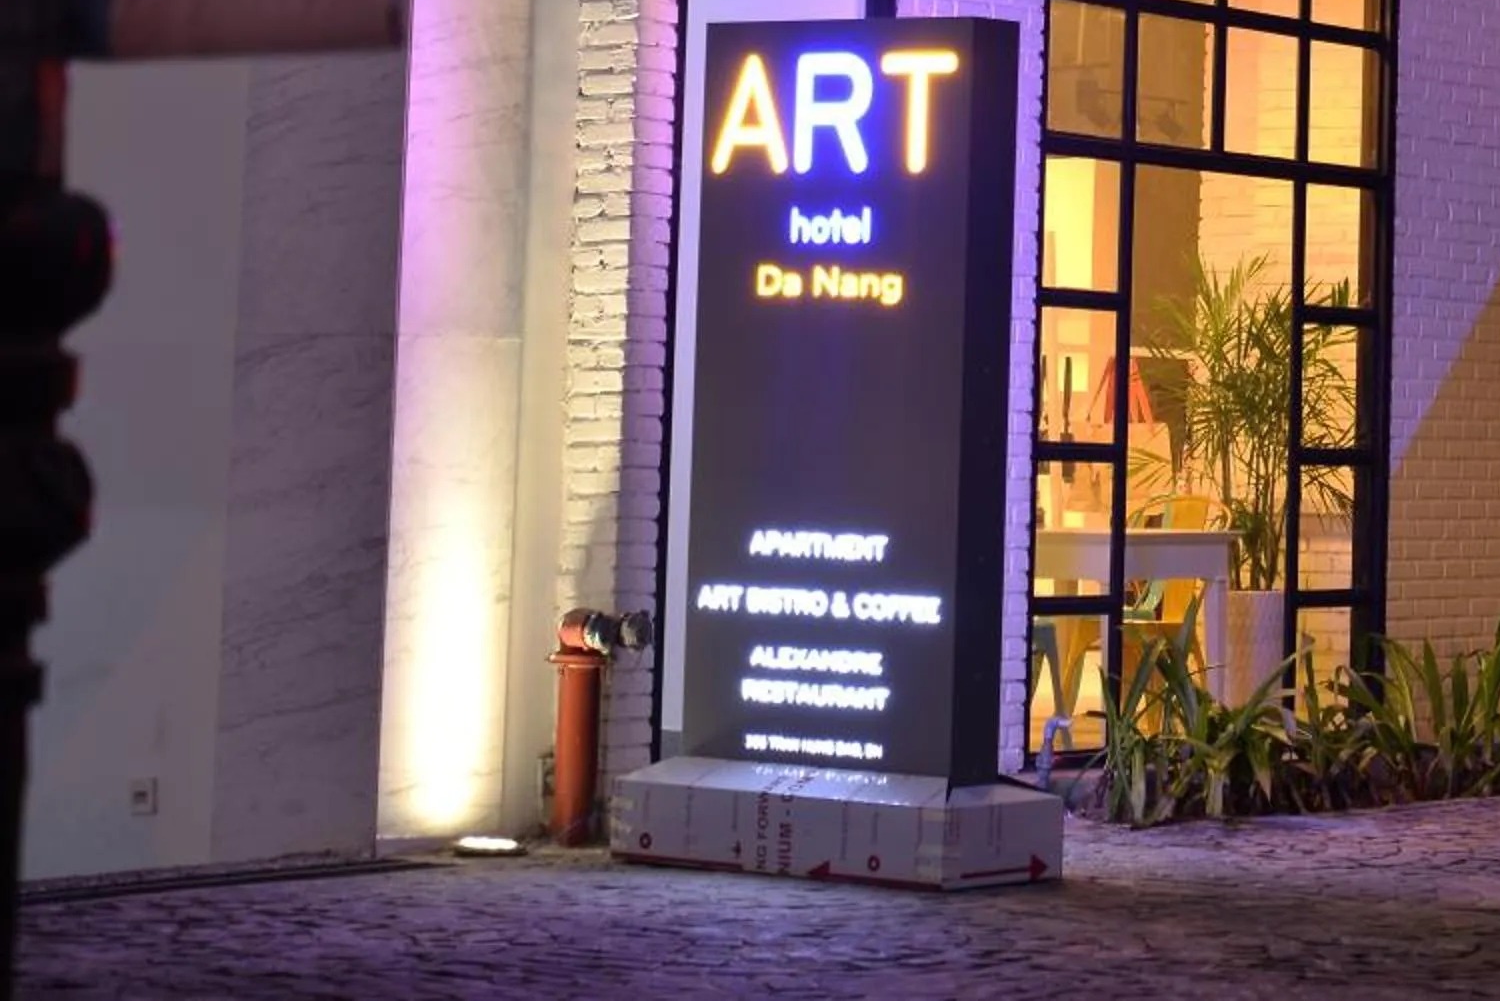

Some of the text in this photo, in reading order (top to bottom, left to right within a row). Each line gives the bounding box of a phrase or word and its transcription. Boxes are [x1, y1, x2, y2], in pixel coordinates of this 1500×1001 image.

[710, 51, 960, 175] ART
[789, 206, 872, 245] hotel
[756, 266, 904, 305] Da Nang
[749, 530, 889, 561] APARTMENT
[697, 585, 941, 623] ART BISTRO & COFFEE
[741, 679, 891, 710] RESTAURANT
